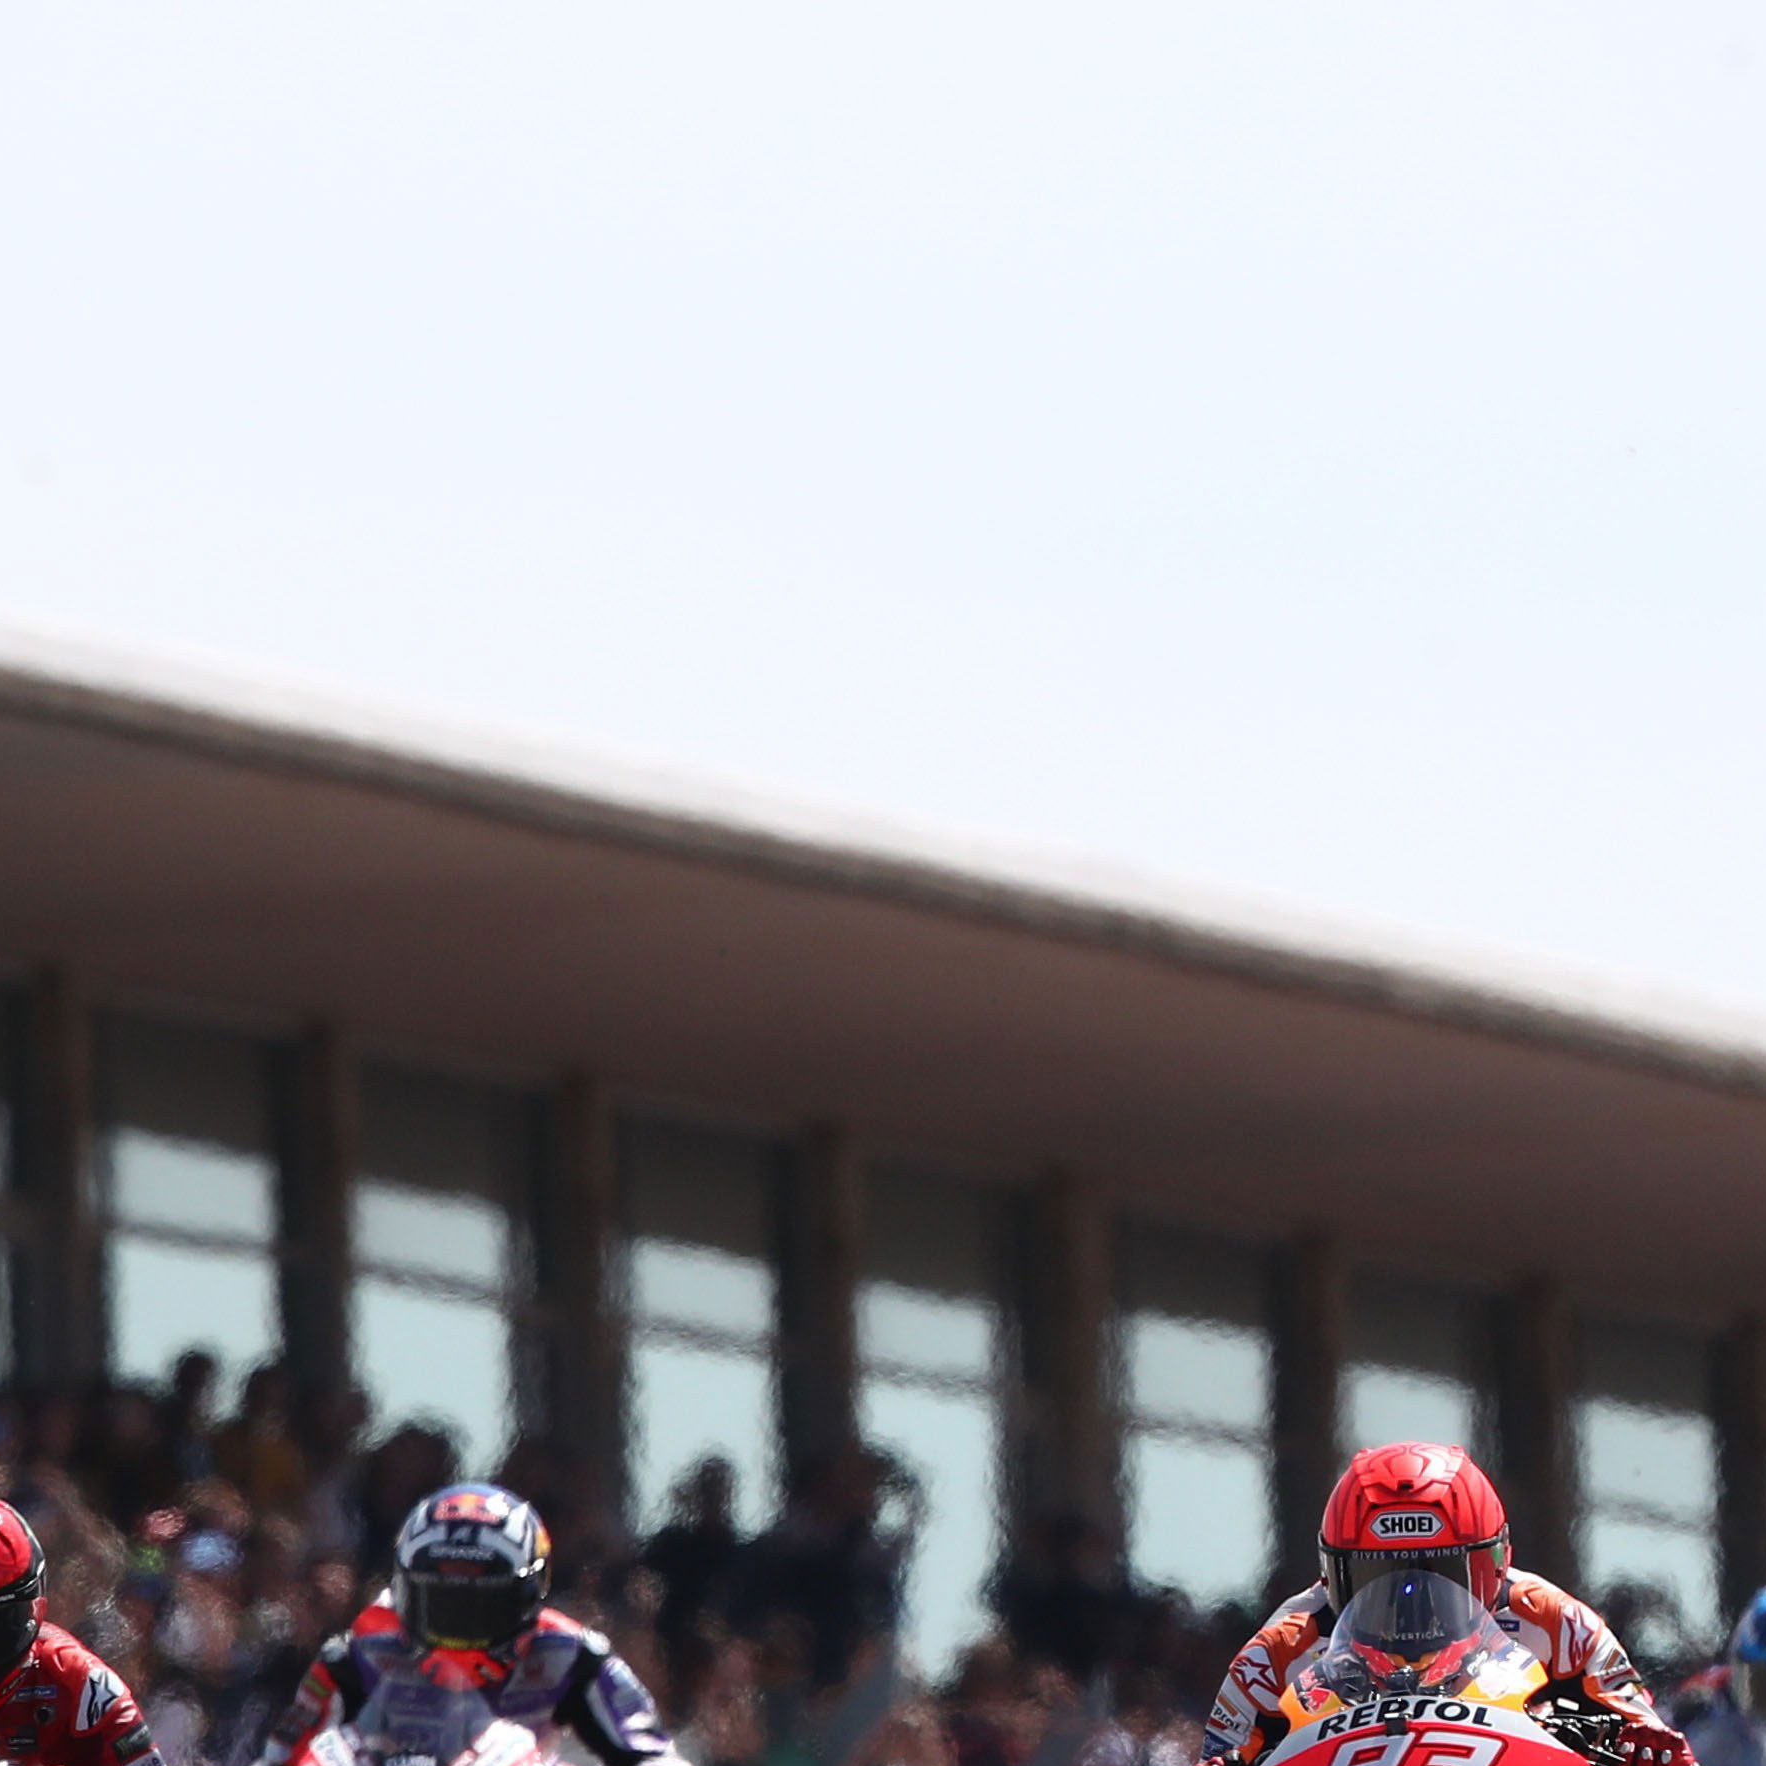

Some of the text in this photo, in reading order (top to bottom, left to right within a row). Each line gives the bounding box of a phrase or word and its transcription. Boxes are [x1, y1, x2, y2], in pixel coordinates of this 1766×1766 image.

[1379, 1516, 1434, 1535] SHOEI
[1352, 1547, 1467, 1561] GIVES YOU WINGS
[1316, 1698, 1493, 1742] REPSOL
